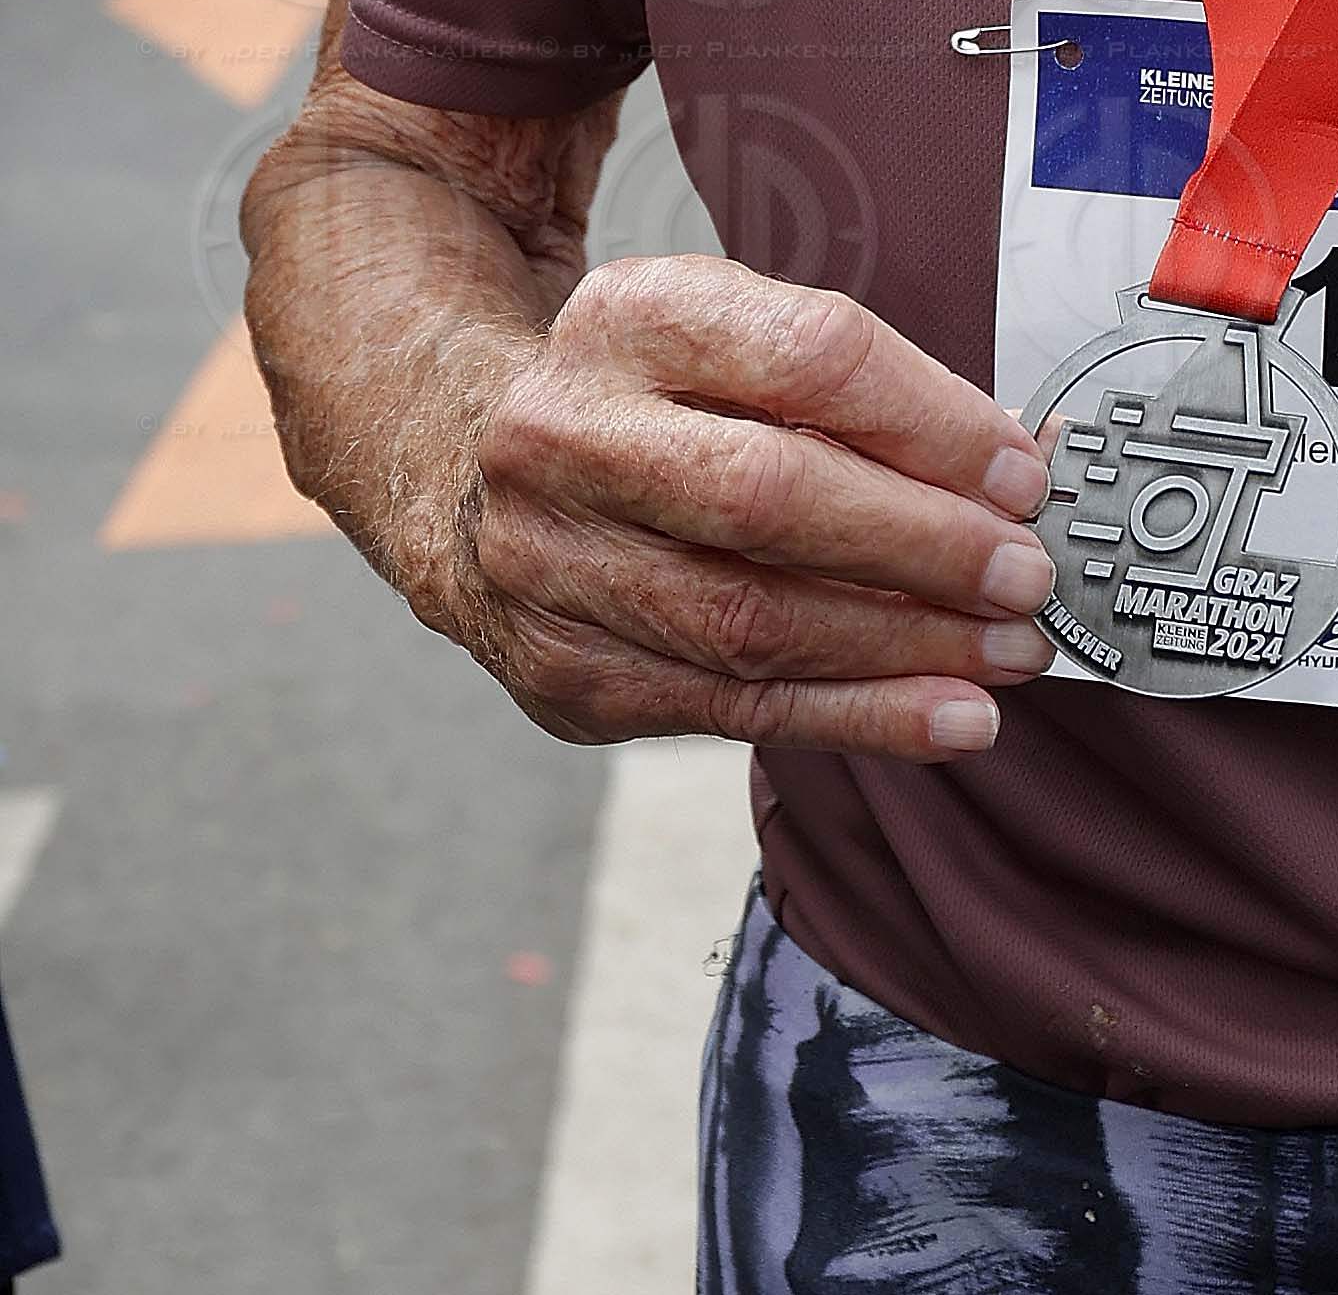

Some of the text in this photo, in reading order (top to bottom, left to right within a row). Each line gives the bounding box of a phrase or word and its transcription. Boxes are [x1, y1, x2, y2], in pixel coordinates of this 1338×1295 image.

[1140, 68, 1214, 91] KLEINE
[1139, 86, 1213, 109] ZEITUNG
[1213, 566, 1299, 602] GRAZ
[1114, 584, 1293, 635] MARATHON
[1042, 595, 1124, 672] INISHER
[1155, 634, 1206, 651] ZEITUNG
[1157, 623, 1207, 640] KLEINE
[1207, 628, 1285, 664] 2024
